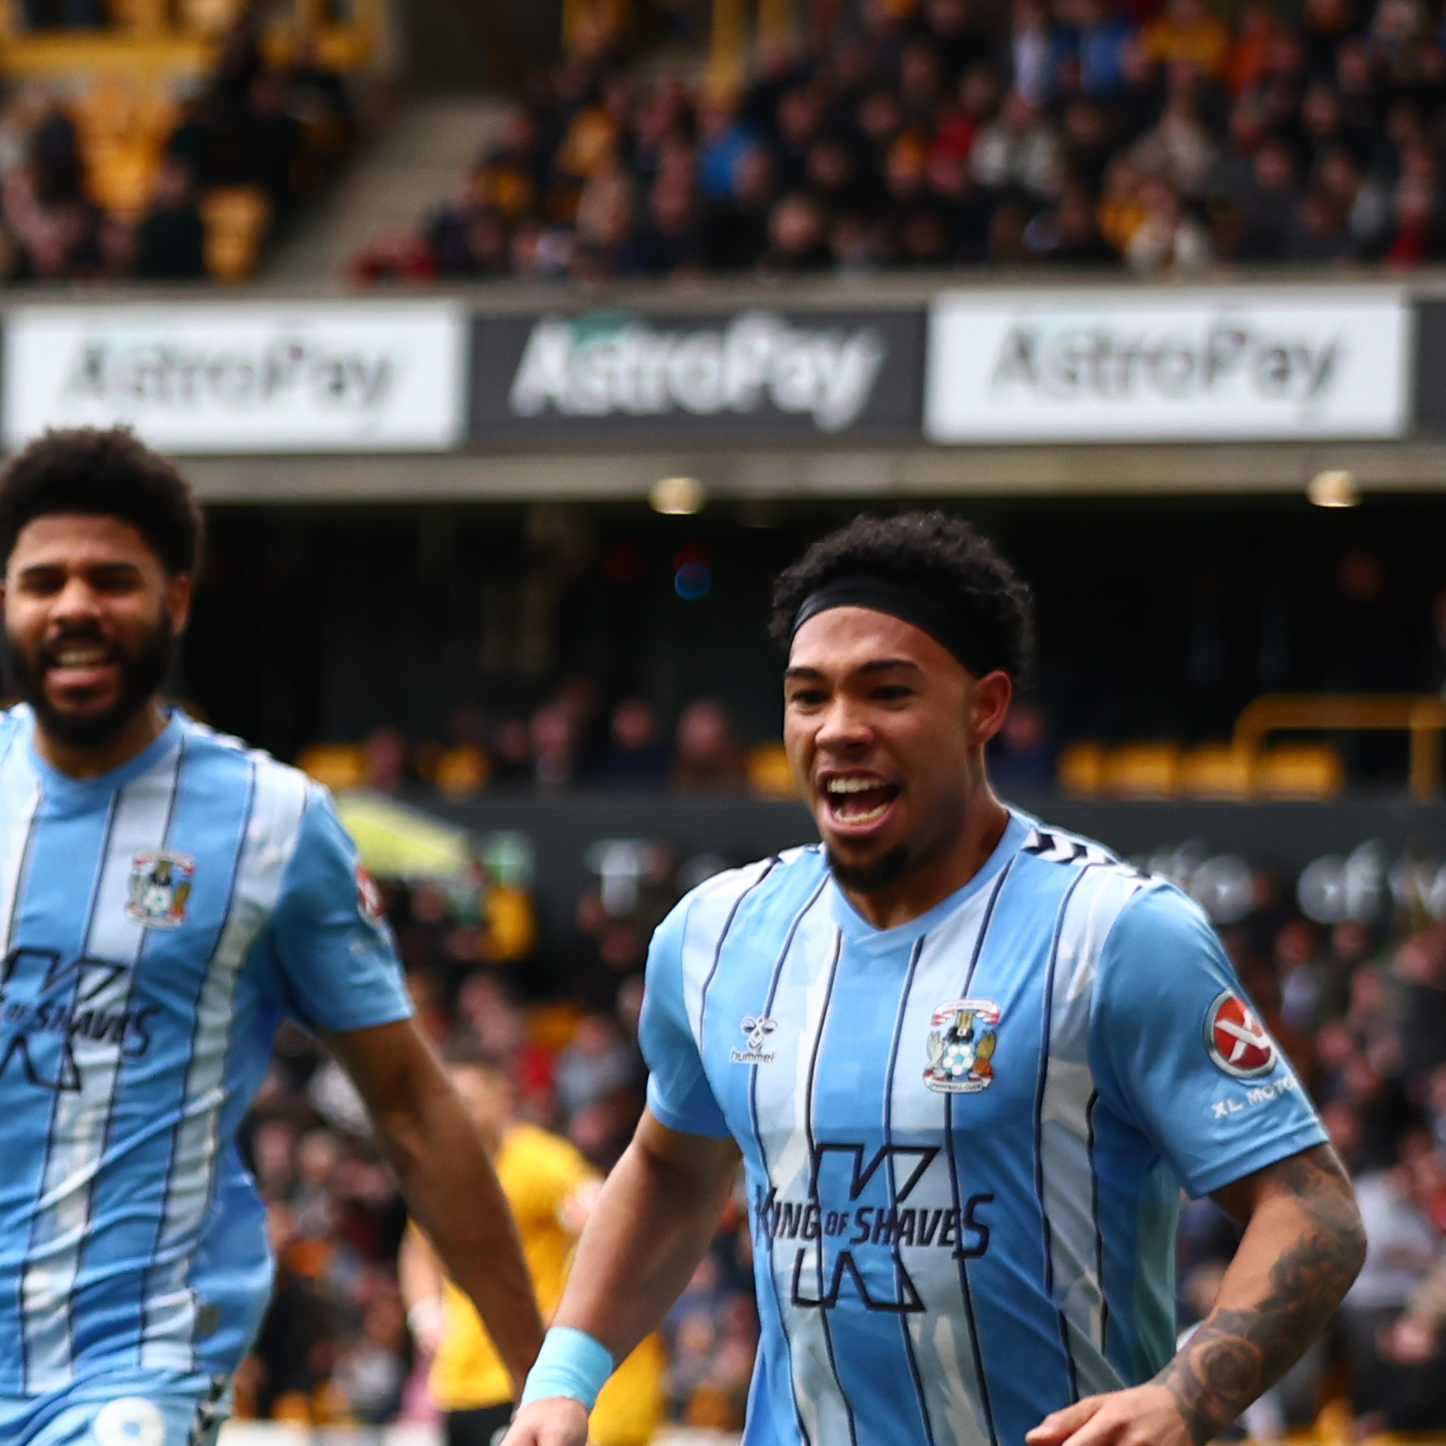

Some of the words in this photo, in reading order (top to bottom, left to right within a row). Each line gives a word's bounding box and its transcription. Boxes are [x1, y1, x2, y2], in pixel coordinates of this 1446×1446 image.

[64, 334, 406, 430] AstroPay
[510, 314, 886, 430] AstroPay
[988, 310, 1348, 420] AstroPay
[1211, 1099, 1246, 1119] XL
[1246, 1076, 1298, 1105] MOTO
[754, 1184, 821, 1252] KING
[824, 1211, 850, 1237] OF
[849, 1193, 995, 1261] SHAVES
